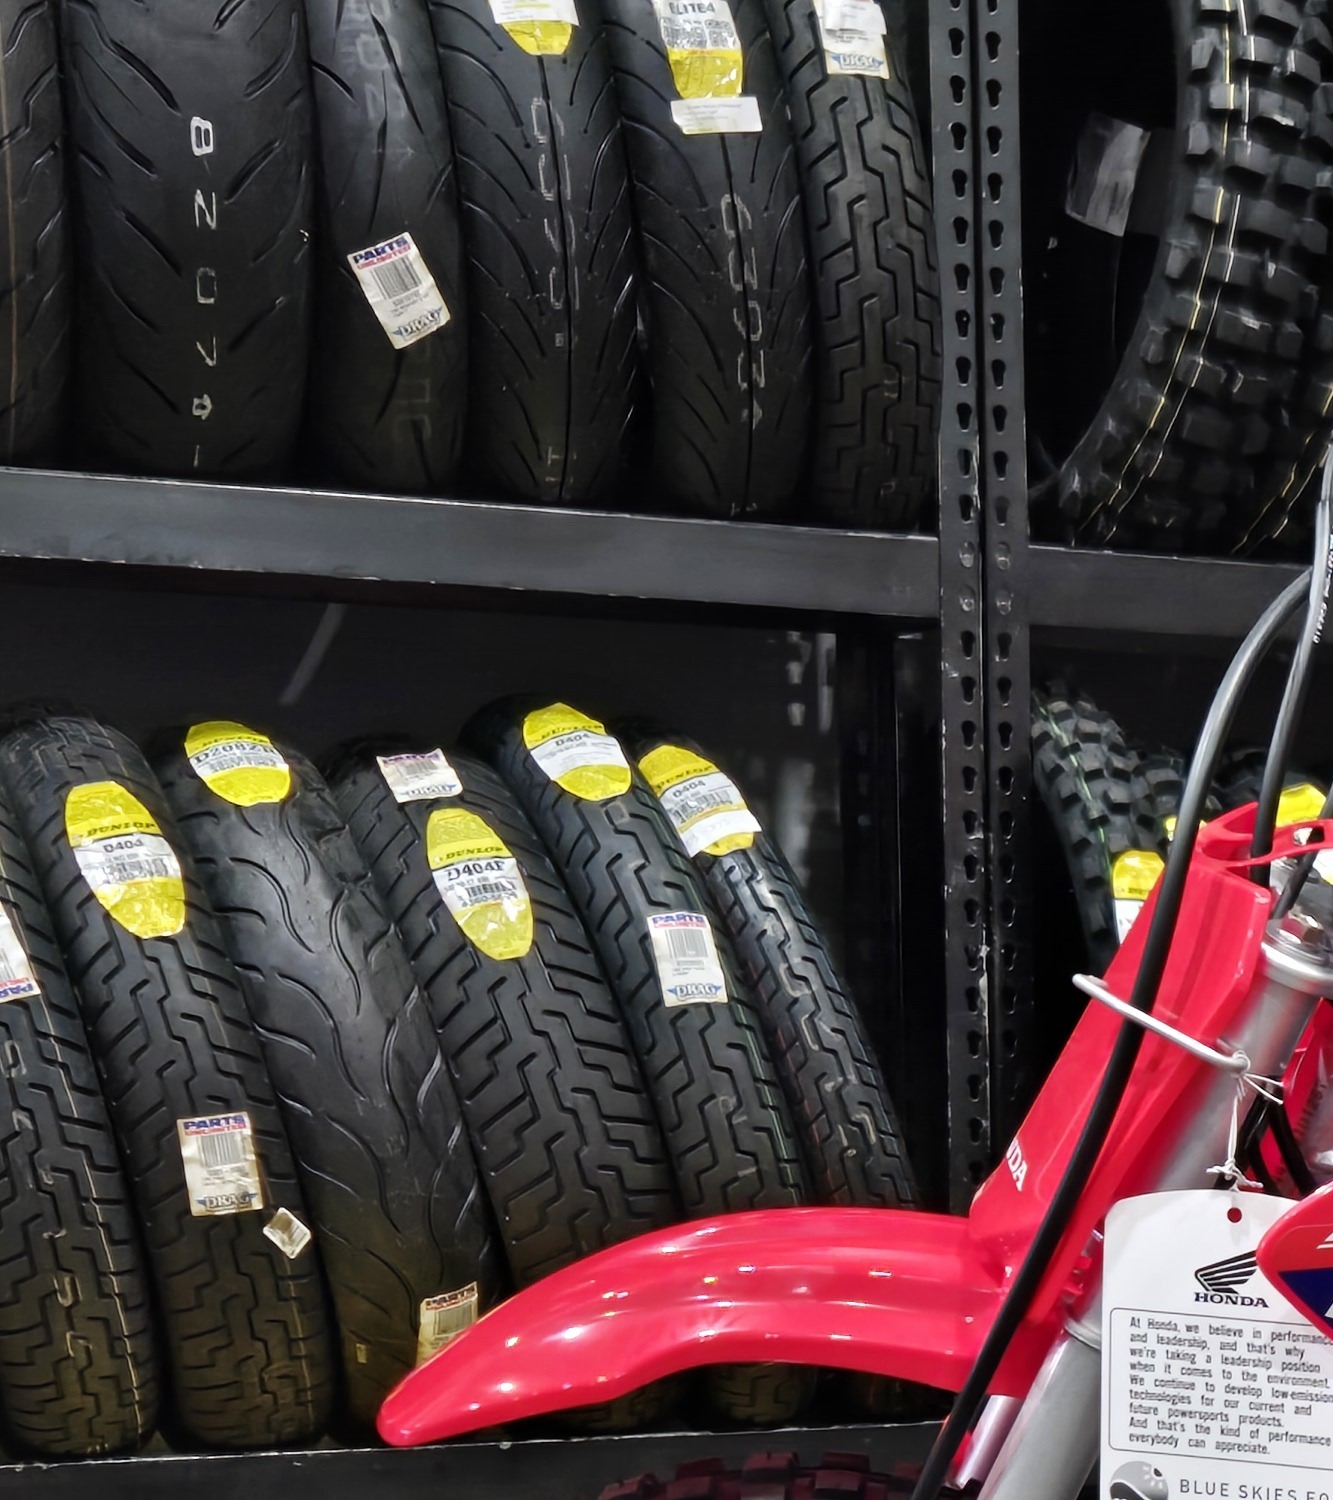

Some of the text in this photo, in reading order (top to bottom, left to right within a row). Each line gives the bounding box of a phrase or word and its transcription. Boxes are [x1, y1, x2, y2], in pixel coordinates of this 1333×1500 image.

[183, 1115, 246, 1130] PARTS
[1194, 1292, 1269, 1308] HONDA
[1130, 1316, 1140, 1328] At
[1185, 1324, 1199, 1333] we
[1208, 1324, 1244, 1338] believe
[1252, 1327, 1262, 1339] in
[1270, 1330, 1333, 1346] performanc
[1130, 1333, 1147, 1343] and
[1219, 1341, 1237, 1351] and
[1247, 1342, 1276, 1355] that's
[1285, 1348, 1305, 1361] why
[1130, 1347, 1320, 1374] we're taking a leadership position
[1130, 1361, 1156, 1373] when
[1164, 1363, 1172, 1374] it
[1180, 1366, 1213, 1378] comes
[1222, 1368, 1232, 1380] to
[1242, 1370, 1258, 1382] the
[1130, 1374, 1145, 1386] We
[1154, 1378, 1196, 1391] continue
[1205, 1381, 1215, 1393] to
[1224, 1383, 1262, 1399] develop
[1129, 1388, 1312, 1416] technologies for our current and
[1129, 1402, 1158, 1415] future
[1168, 1406, 1229, 1423] powersports
[1129, 1416, 1332, 1447] And that's the kind of performance
[1129, 1431, 1179, 1448] everybody
[1188, 1438, 1206, 1448] can
[1180, 1479, 1229, 1497] BLUE
